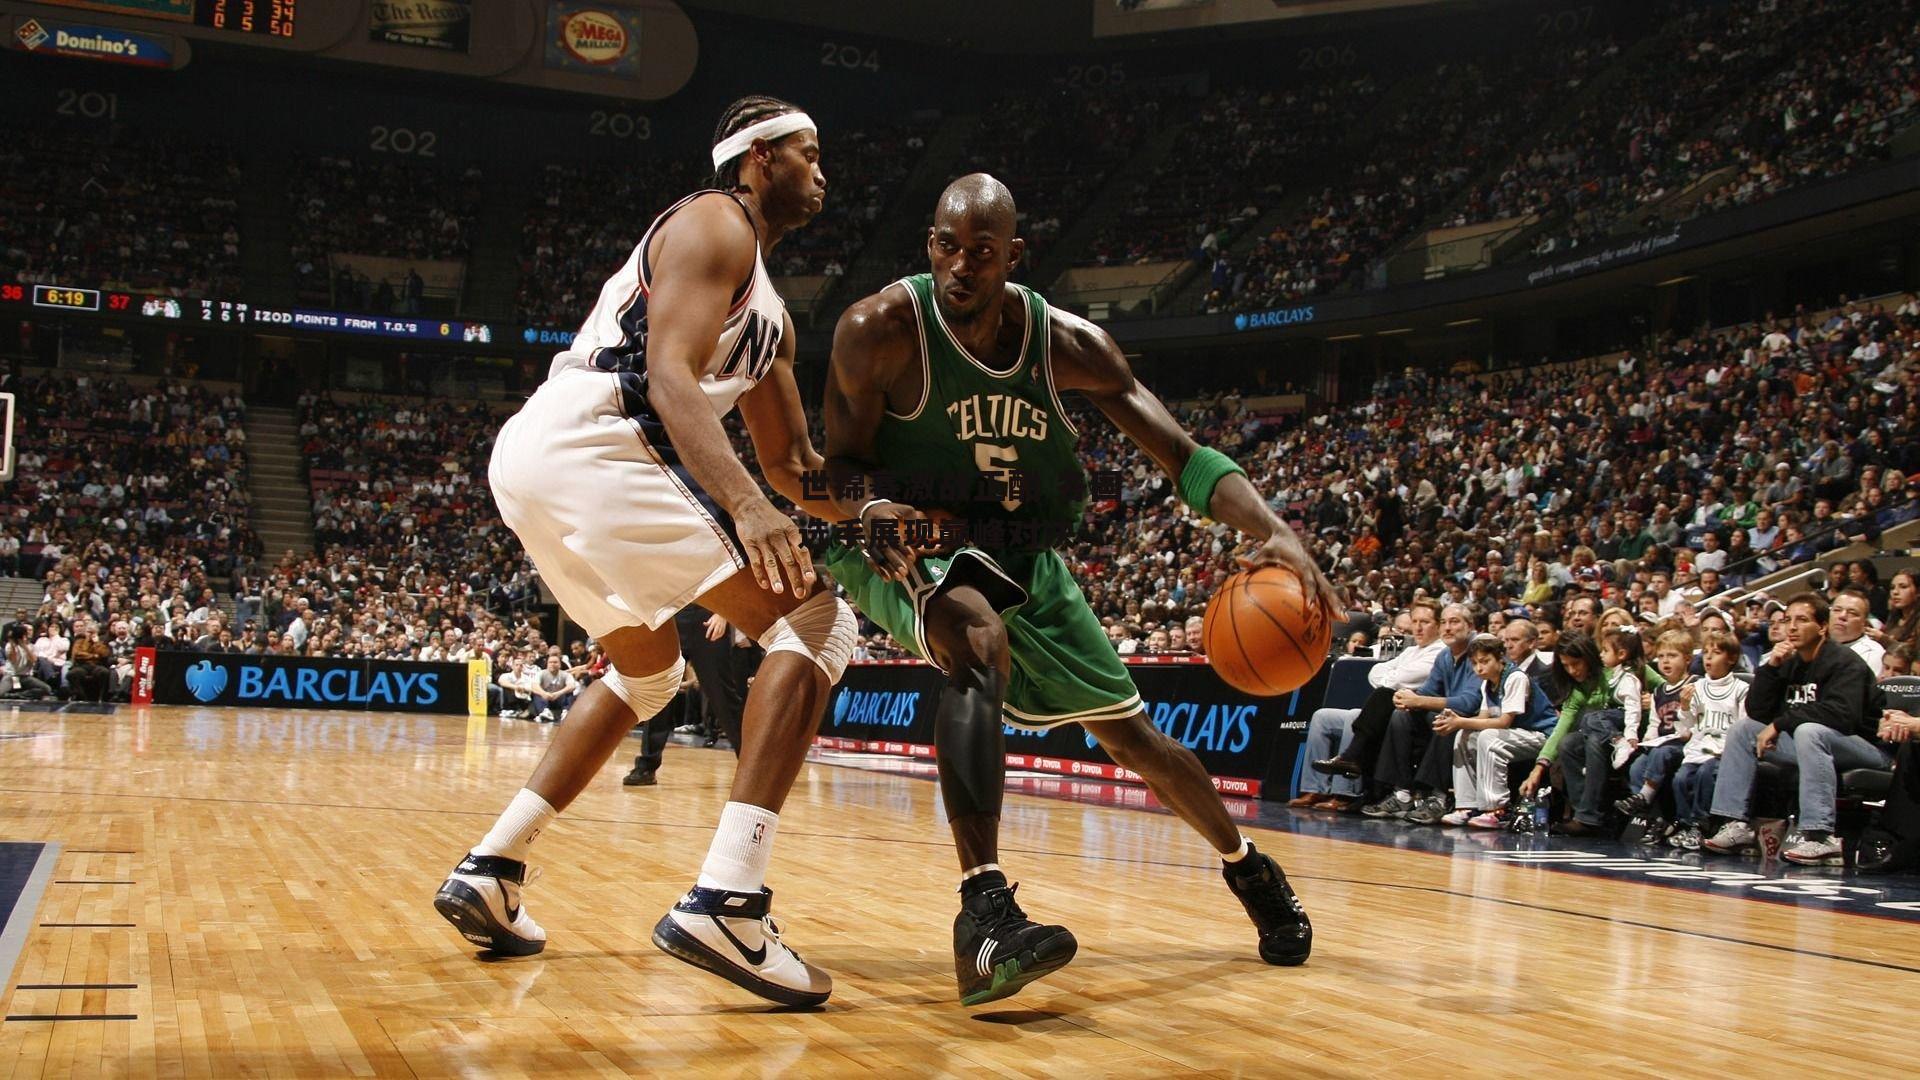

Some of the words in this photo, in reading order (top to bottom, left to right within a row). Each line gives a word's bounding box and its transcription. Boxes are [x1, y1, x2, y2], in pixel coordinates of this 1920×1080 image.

[577, 20, 622, 42] MEGA
[55, 29, 139, 56] Domino's
[821, 42, 881, 72] 204
[56, 88, 118, 120] 201
[589, 110, 651, 141] 203
[369, 125, 437, 157] 202
[47, 289, 85, 306] 6:19
[109, 295, 131, 310] 37
[202, 309, 212, 320] 2
[238, 312, 246, 323] 1
[254, 310, 293, 324] IZOD
[295, 313, 338, 326] POINTS
[344, 318, 377, 330] FROM
[1250, 306, 1313, 328] BARCLAYS
[440, 323, 450, 336] 6
[946, 394, 1048, 441] CELTICS
[238, 665, 439, 705] BARCLAYS
[847, 690, 920, 728] BARCLAYS
[1143, 701, 1258, 754] RCLAYS
[1280, 721, 1307, 730] MARQUIS
[1042, 759, 1062, 770] TOYOTA
[1081, 763, 1103, 776] TOYOTA
[1222, 780, 1249, 793] TOYOTA
